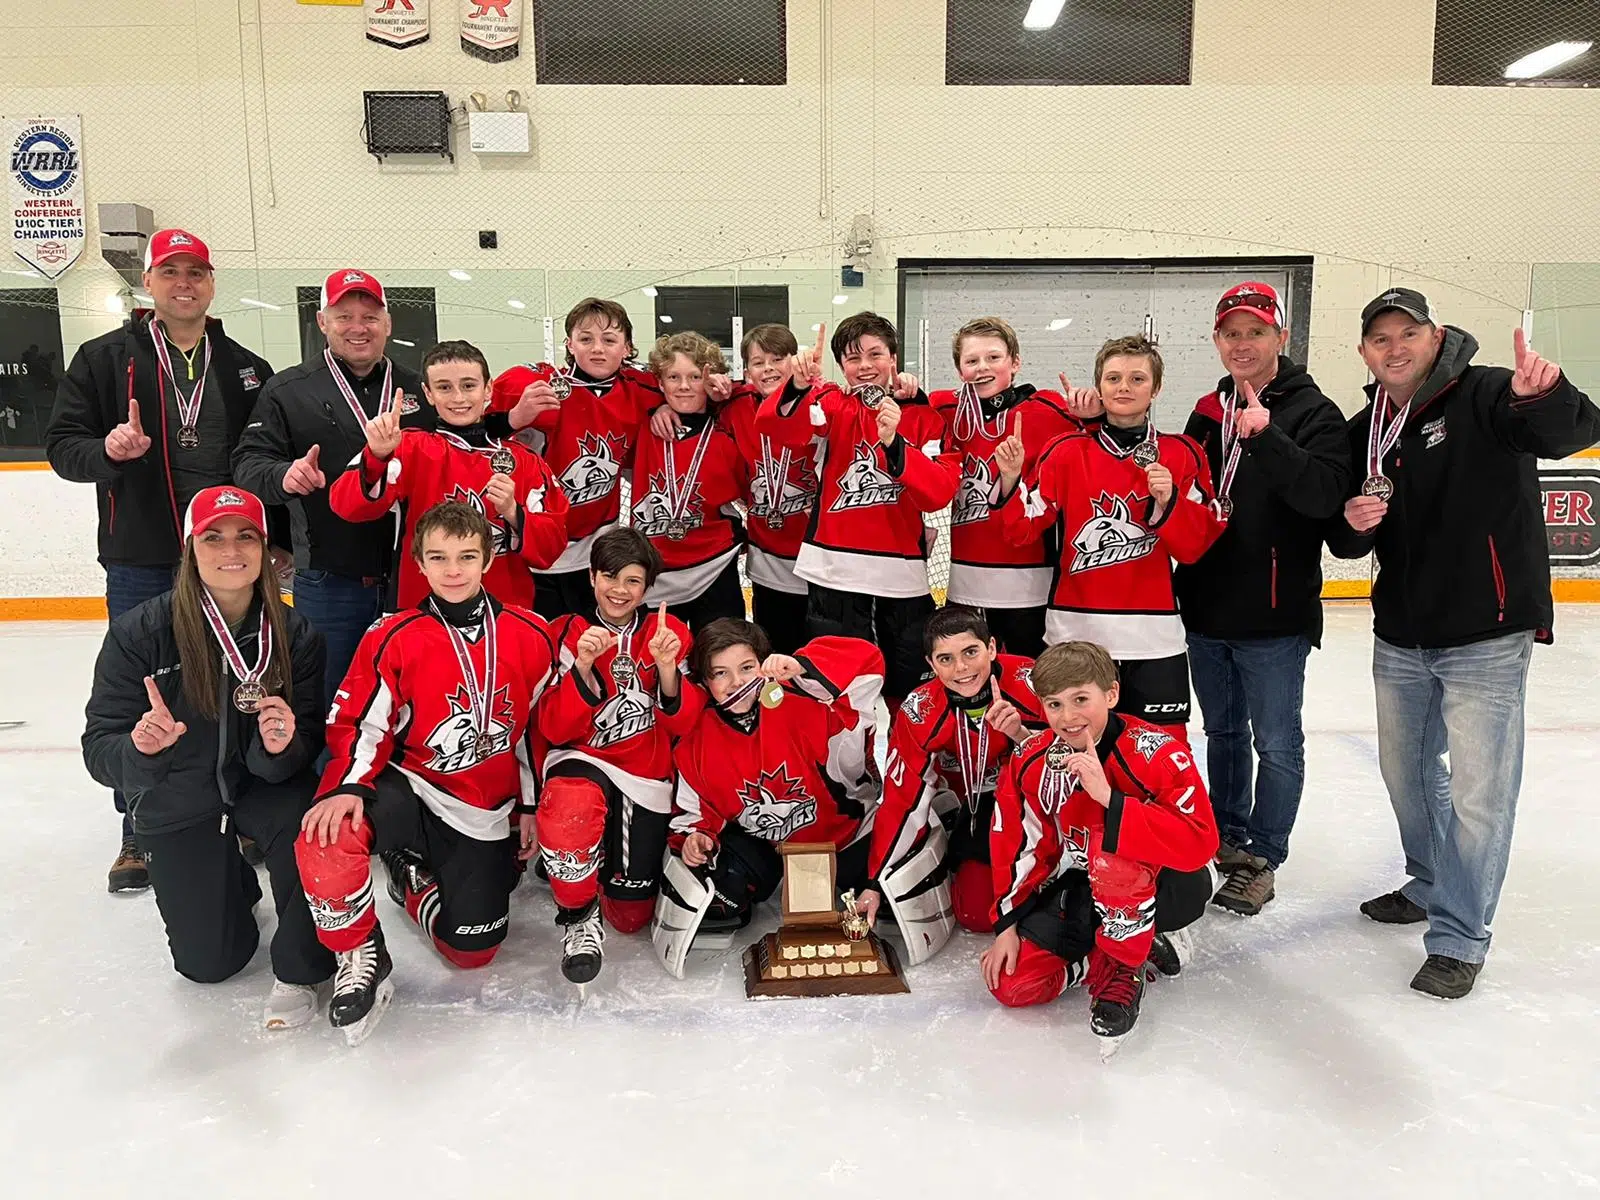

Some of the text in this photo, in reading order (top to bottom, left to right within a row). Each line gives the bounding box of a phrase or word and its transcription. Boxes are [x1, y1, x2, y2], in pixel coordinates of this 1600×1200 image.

[368, 17, 427, 26] TOURNAMENT CHAMPIONS
[462, 21, 493, 32] TOURNAMENT
[13, 125, 75, 148] WESTERN REGION
[11, 151, 79, 172] WRRL
[15, 172, 78, 198] RINGETTE LEAGUE
[24, 200, 74, 208] WESTERN
[14, 208, 82, 218] CONFERENCE
[15, 218, 83, 228] U10C TIER 1
[14, 229, 84, 239] CHAMPIONS
[1541, 491, 1596, 525] ER
[1071, 537, 1157, 572] ICEDOGS
[1143, 702, 1188, 713] CCM
